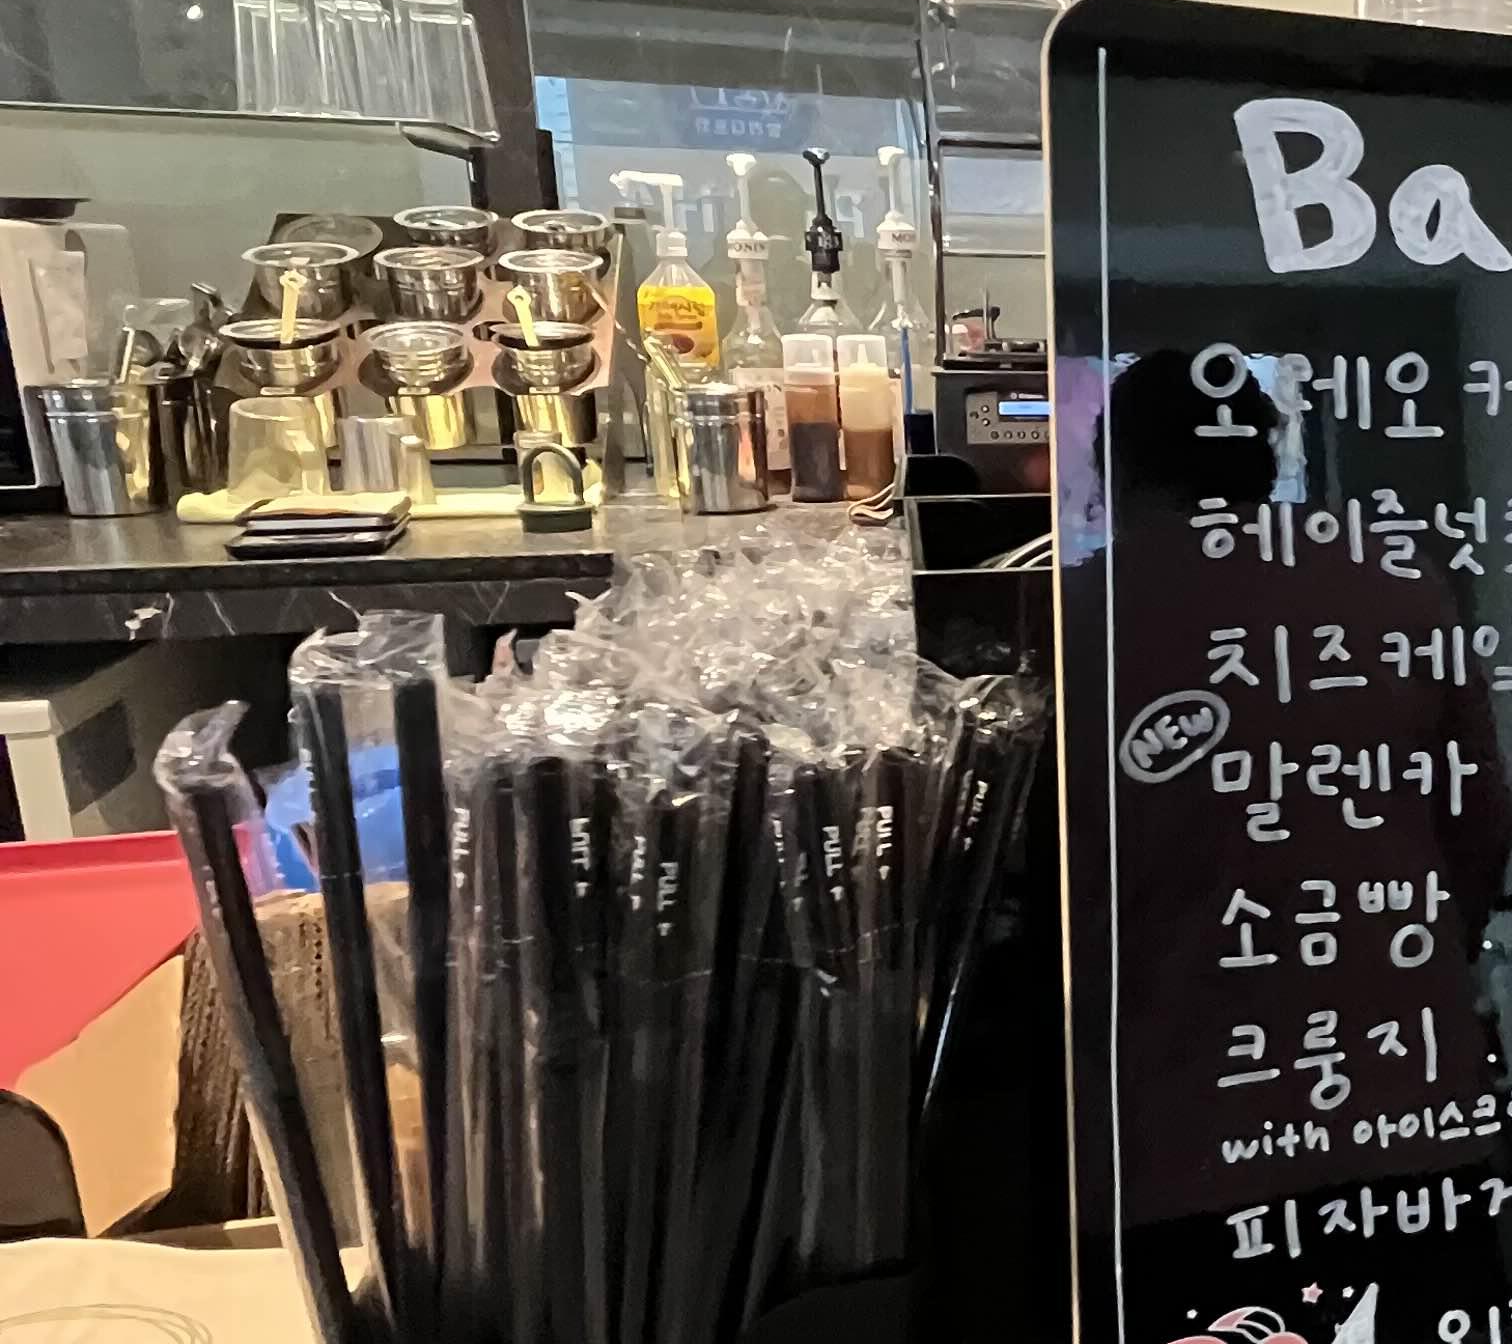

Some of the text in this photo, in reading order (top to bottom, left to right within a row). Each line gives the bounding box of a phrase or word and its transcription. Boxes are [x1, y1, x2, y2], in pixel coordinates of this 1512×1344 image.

[1190, 342, 1445, 439] 오레오
[1130, 706, 1214, 769] NEW
[875, 806, 894, 856] PULL
[1210, 740, 1479, 843] 말렌카
[1219, 870, 1450, 968] 소금빵
[1217, 1007, 1437, 1110] 크룽지
[1221, 1121, 1330, 1163] with
